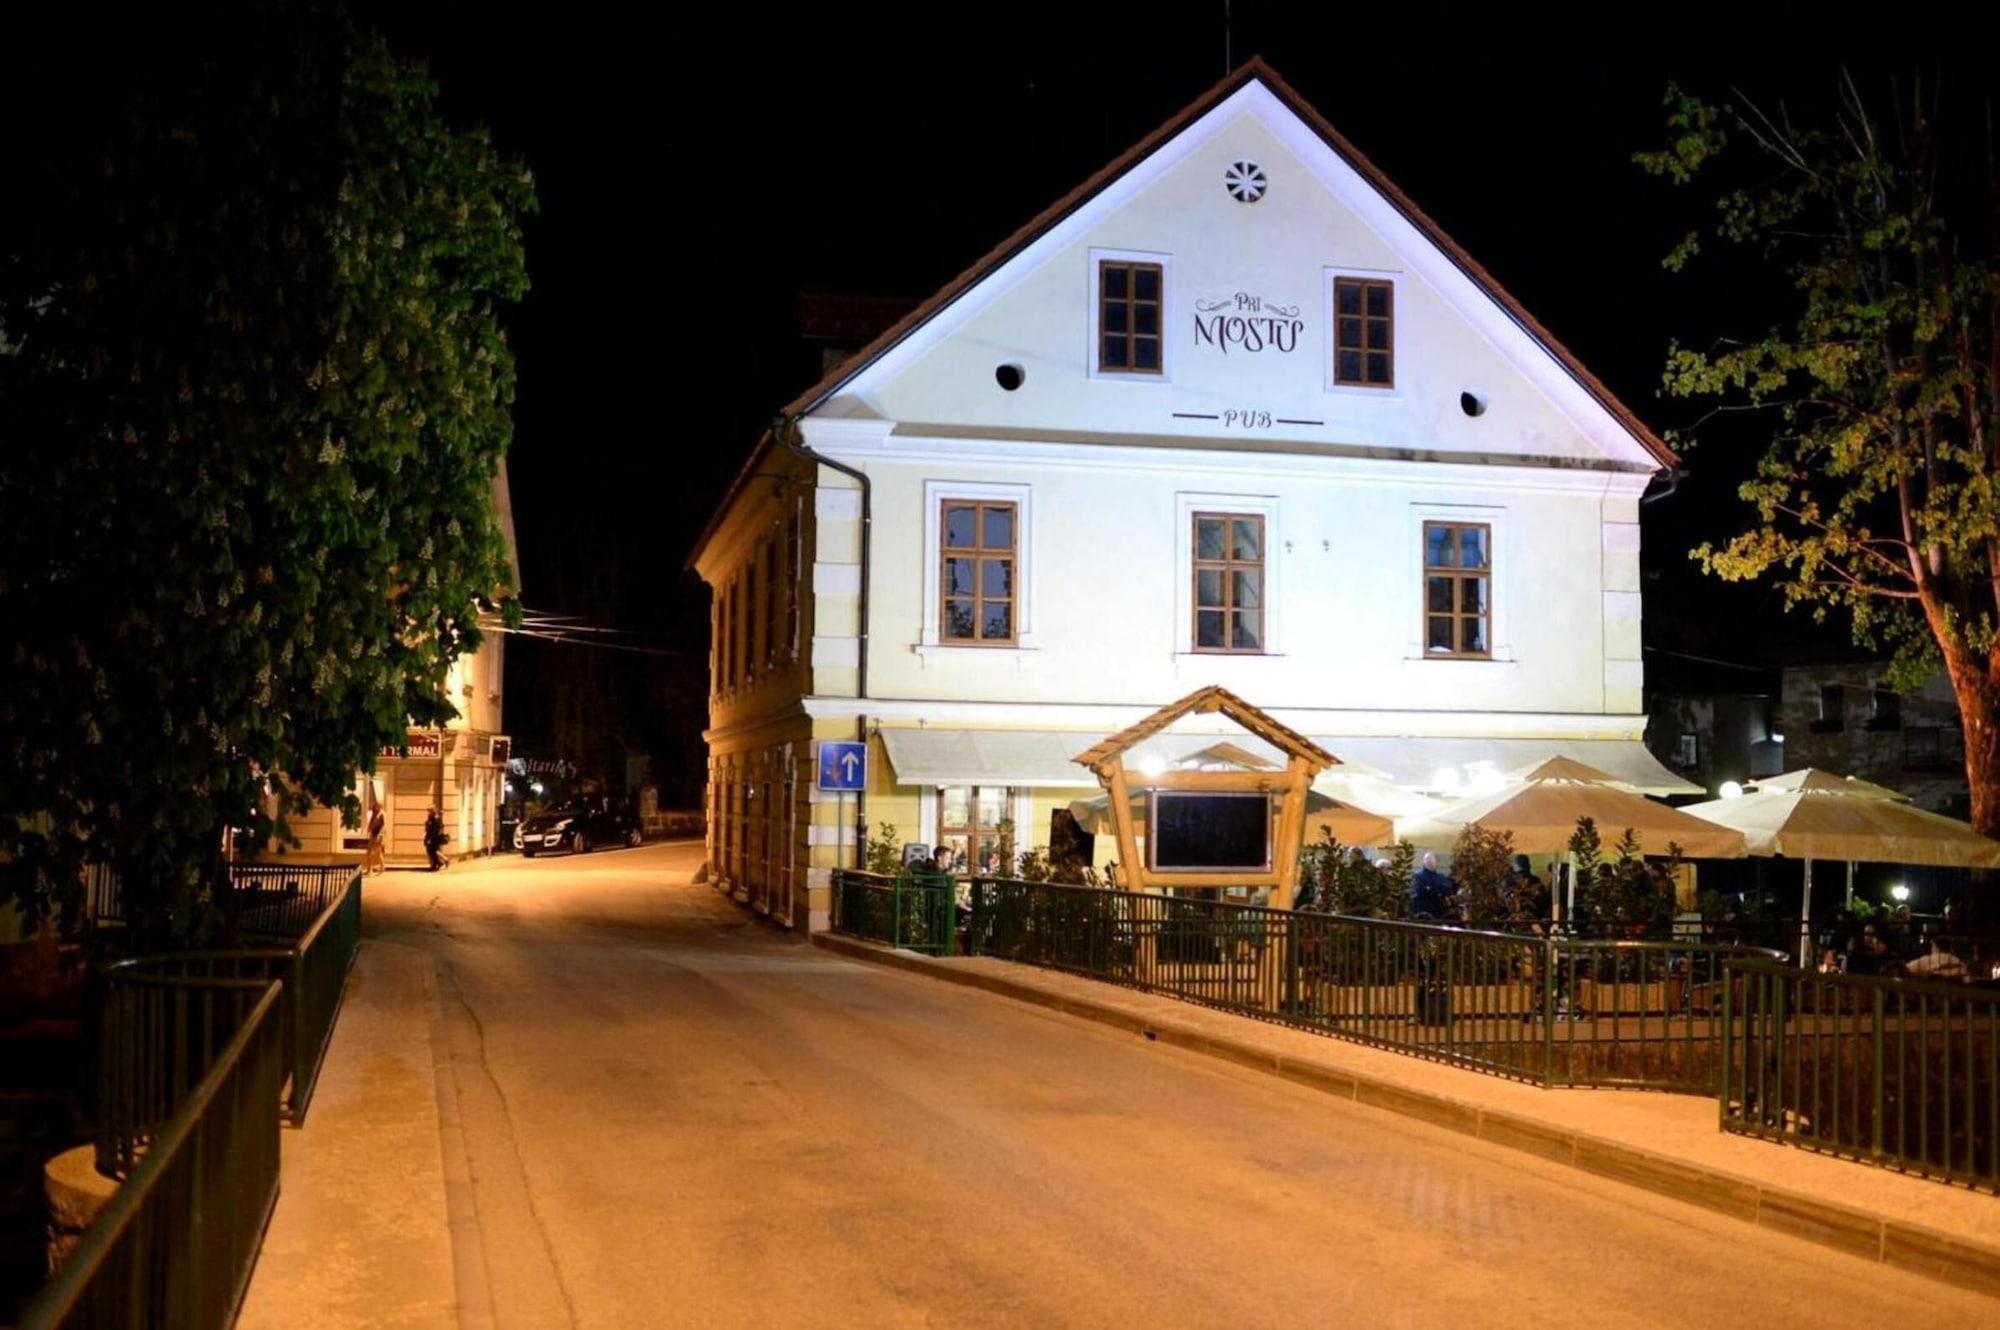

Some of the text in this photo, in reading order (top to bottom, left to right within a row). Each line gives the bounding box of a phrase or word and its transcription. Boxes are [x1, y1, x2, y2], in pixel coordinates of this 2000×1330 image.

[1235, 292, 1261, 312] PRI
[1195, 314, 1304, 356] MOSTU
[1223, 409, 1273, 429] PUB
